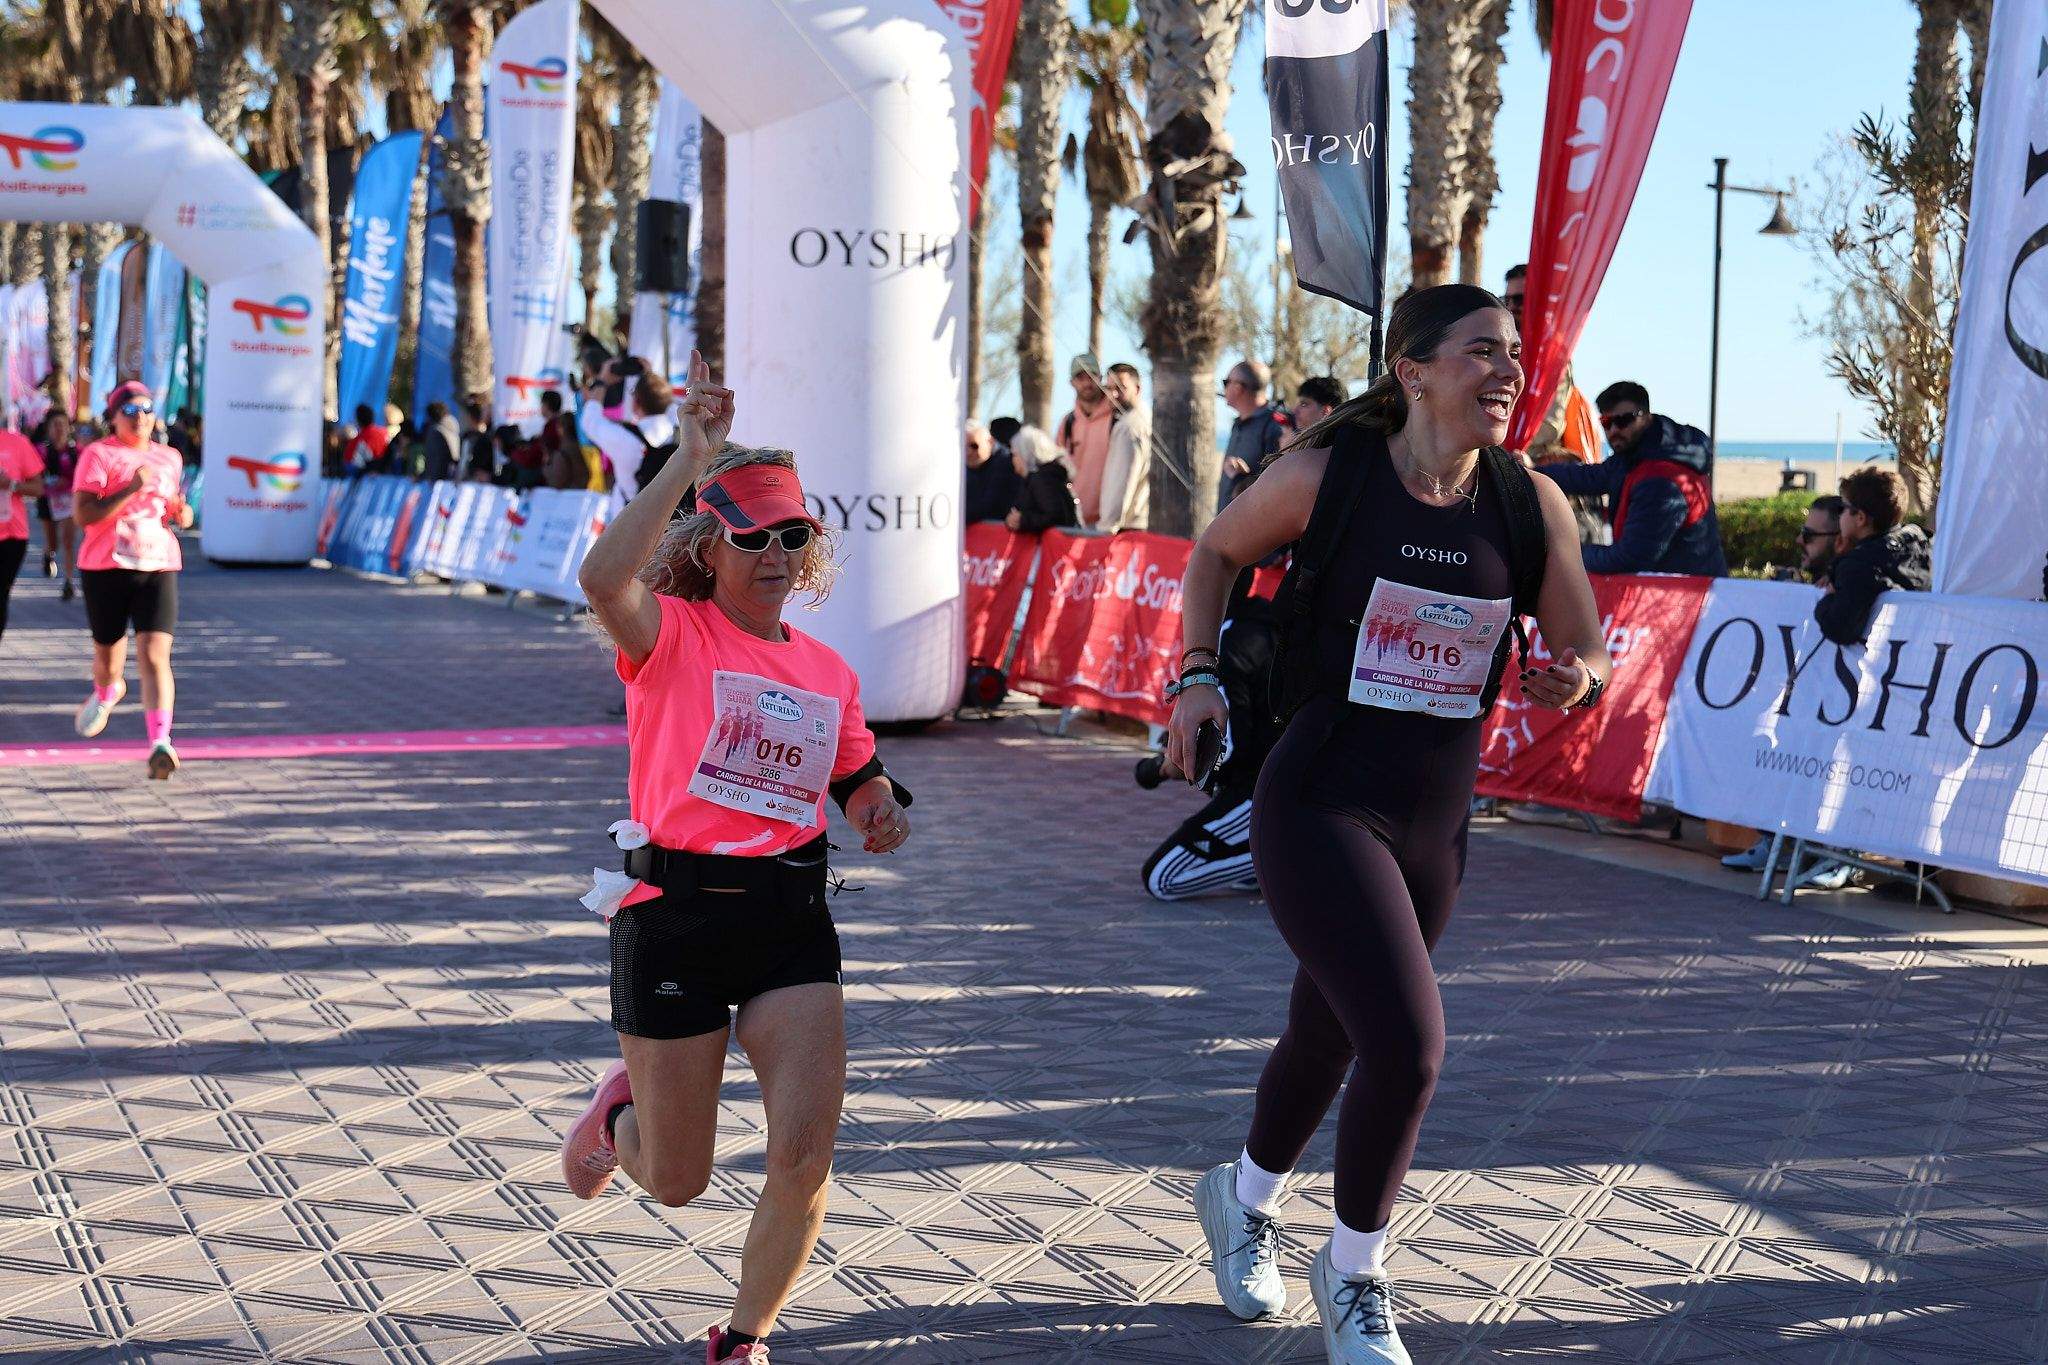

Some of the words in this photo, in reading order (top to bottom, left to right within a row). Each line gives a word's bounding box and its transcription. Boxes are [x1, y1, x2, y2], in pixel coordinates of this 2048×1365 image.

[791, 227, 957, 271] OYSHO
[1401, 544, 1468, 565] OYSHO
[1408, 640, 1461, 667] 016
[1372, 673, 1403, 684] CARRERA
[1404, 678, 1413, 686] DE
[1414, 680, 1423, 688] LA
[1424, 682, 1446, 692] MUJER
[1420, 668, 1440, 680] 107
[1696, 617, 2039, 749] OYSHO
[1367, 687, 1412, 703] OYSHO
[760, 697, 800, 718] ASTURIANA
[756, 738, 803, 767] 016
[758, 767, 781, 780] 3286
[707, 783, 751, 803] OYSHO
[753, 780, 761, 788] LA
[762, 781, 784, 793] MUJER
